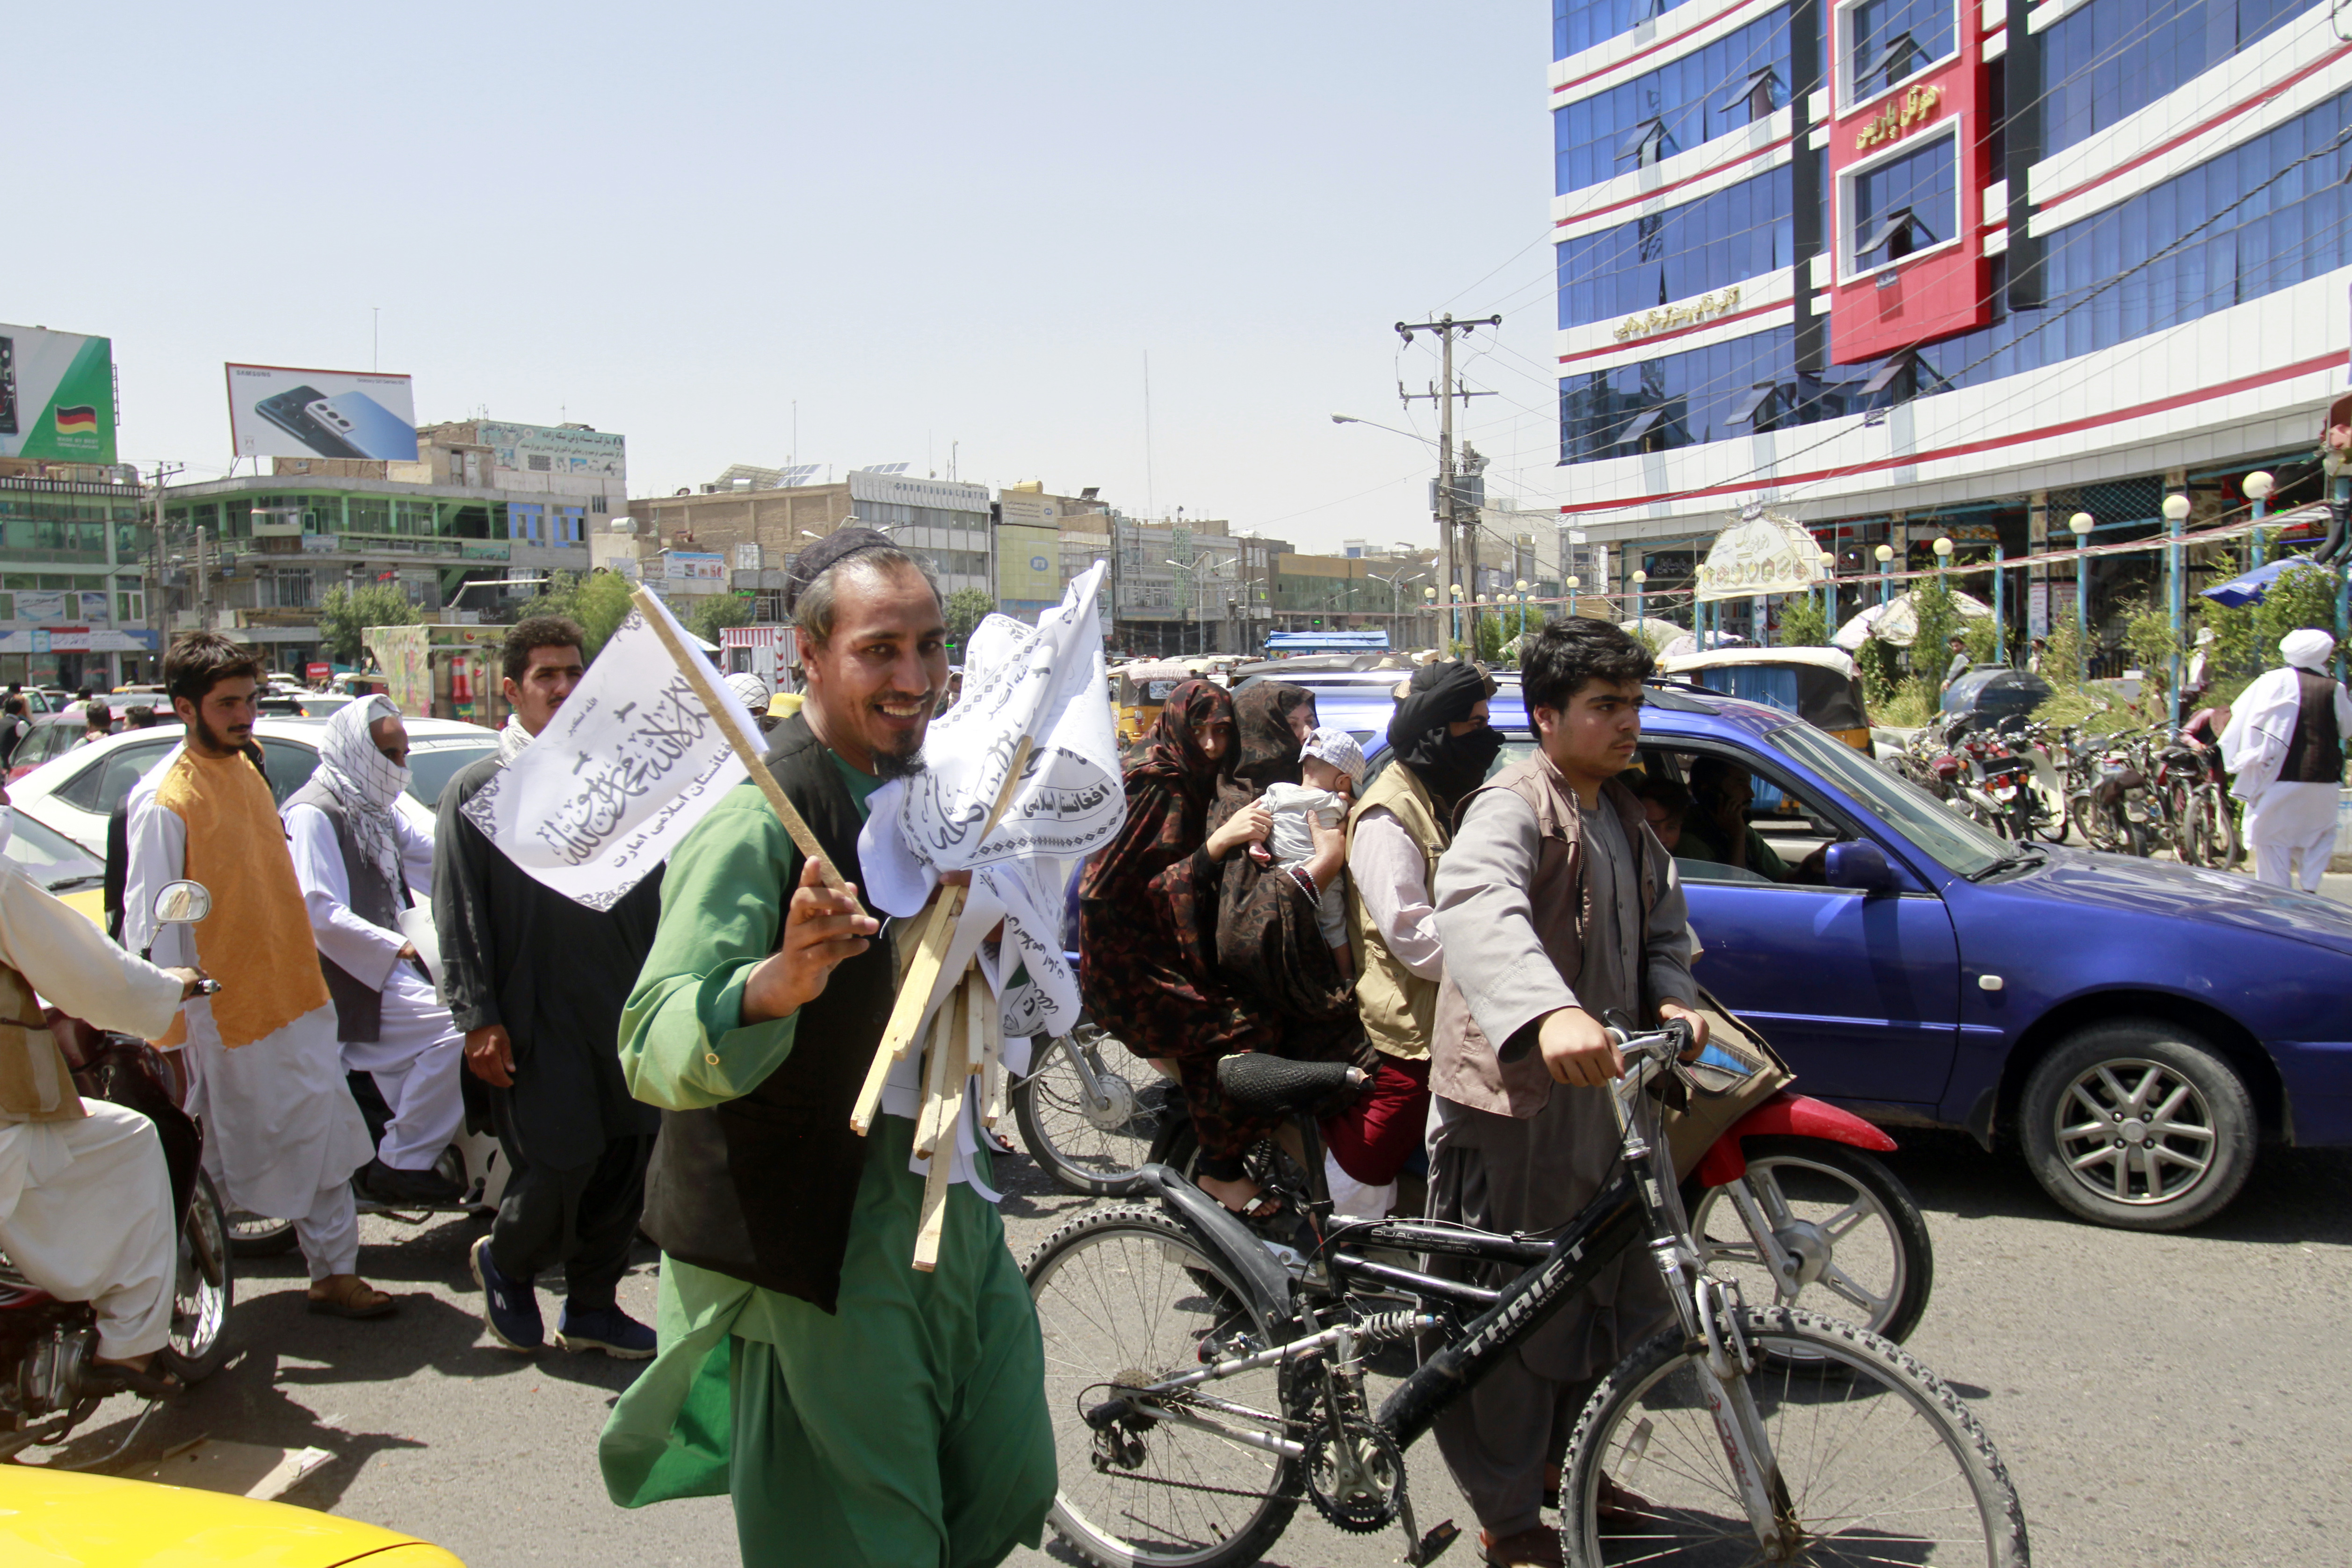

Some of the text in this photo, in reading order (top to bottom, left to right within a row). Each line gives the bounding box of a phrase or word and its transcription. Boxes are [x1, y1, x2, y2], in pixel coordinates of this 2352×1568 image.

[1855, 85, 1940, 150] هوتل پاریس
[1371, 1228, 1414, 1240] DUAL
[1371, 1237, 1480, 1254] SUSPENSION
[1497, 1271, 1574, 1344] VELO MODE
